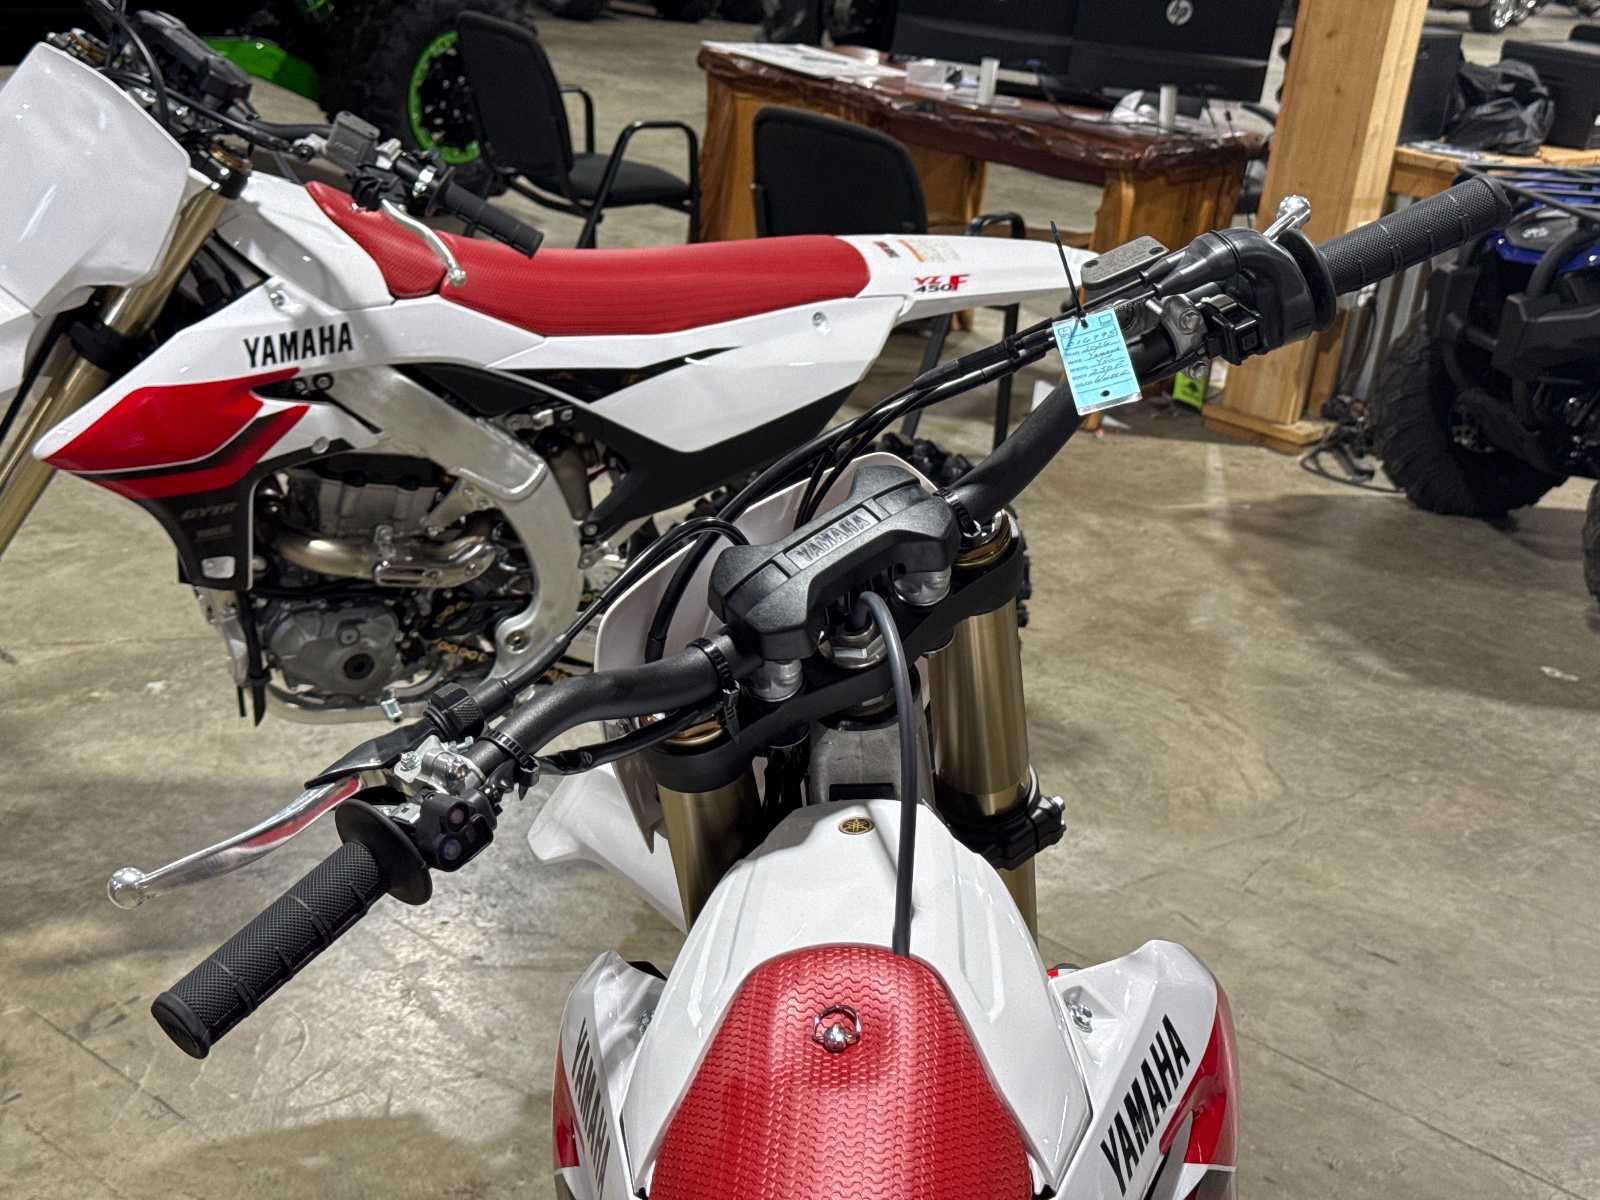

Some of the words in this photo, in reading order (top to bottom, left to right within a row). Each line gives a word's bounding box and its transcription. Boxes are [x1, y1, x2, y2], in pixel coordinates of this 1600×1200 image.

[1168, 0, 1192, 25] hp
[914, 275, 942, 285] YZ
[914, 284, 952, 292] 450
[243, 322, 354, 368] YAMAHA
[796, 514, 870, 561] YAMAHA
[571, 1016, 611, 1200] YAMAHA
[1100, 1013, 1191, 1197] YAMAHA
